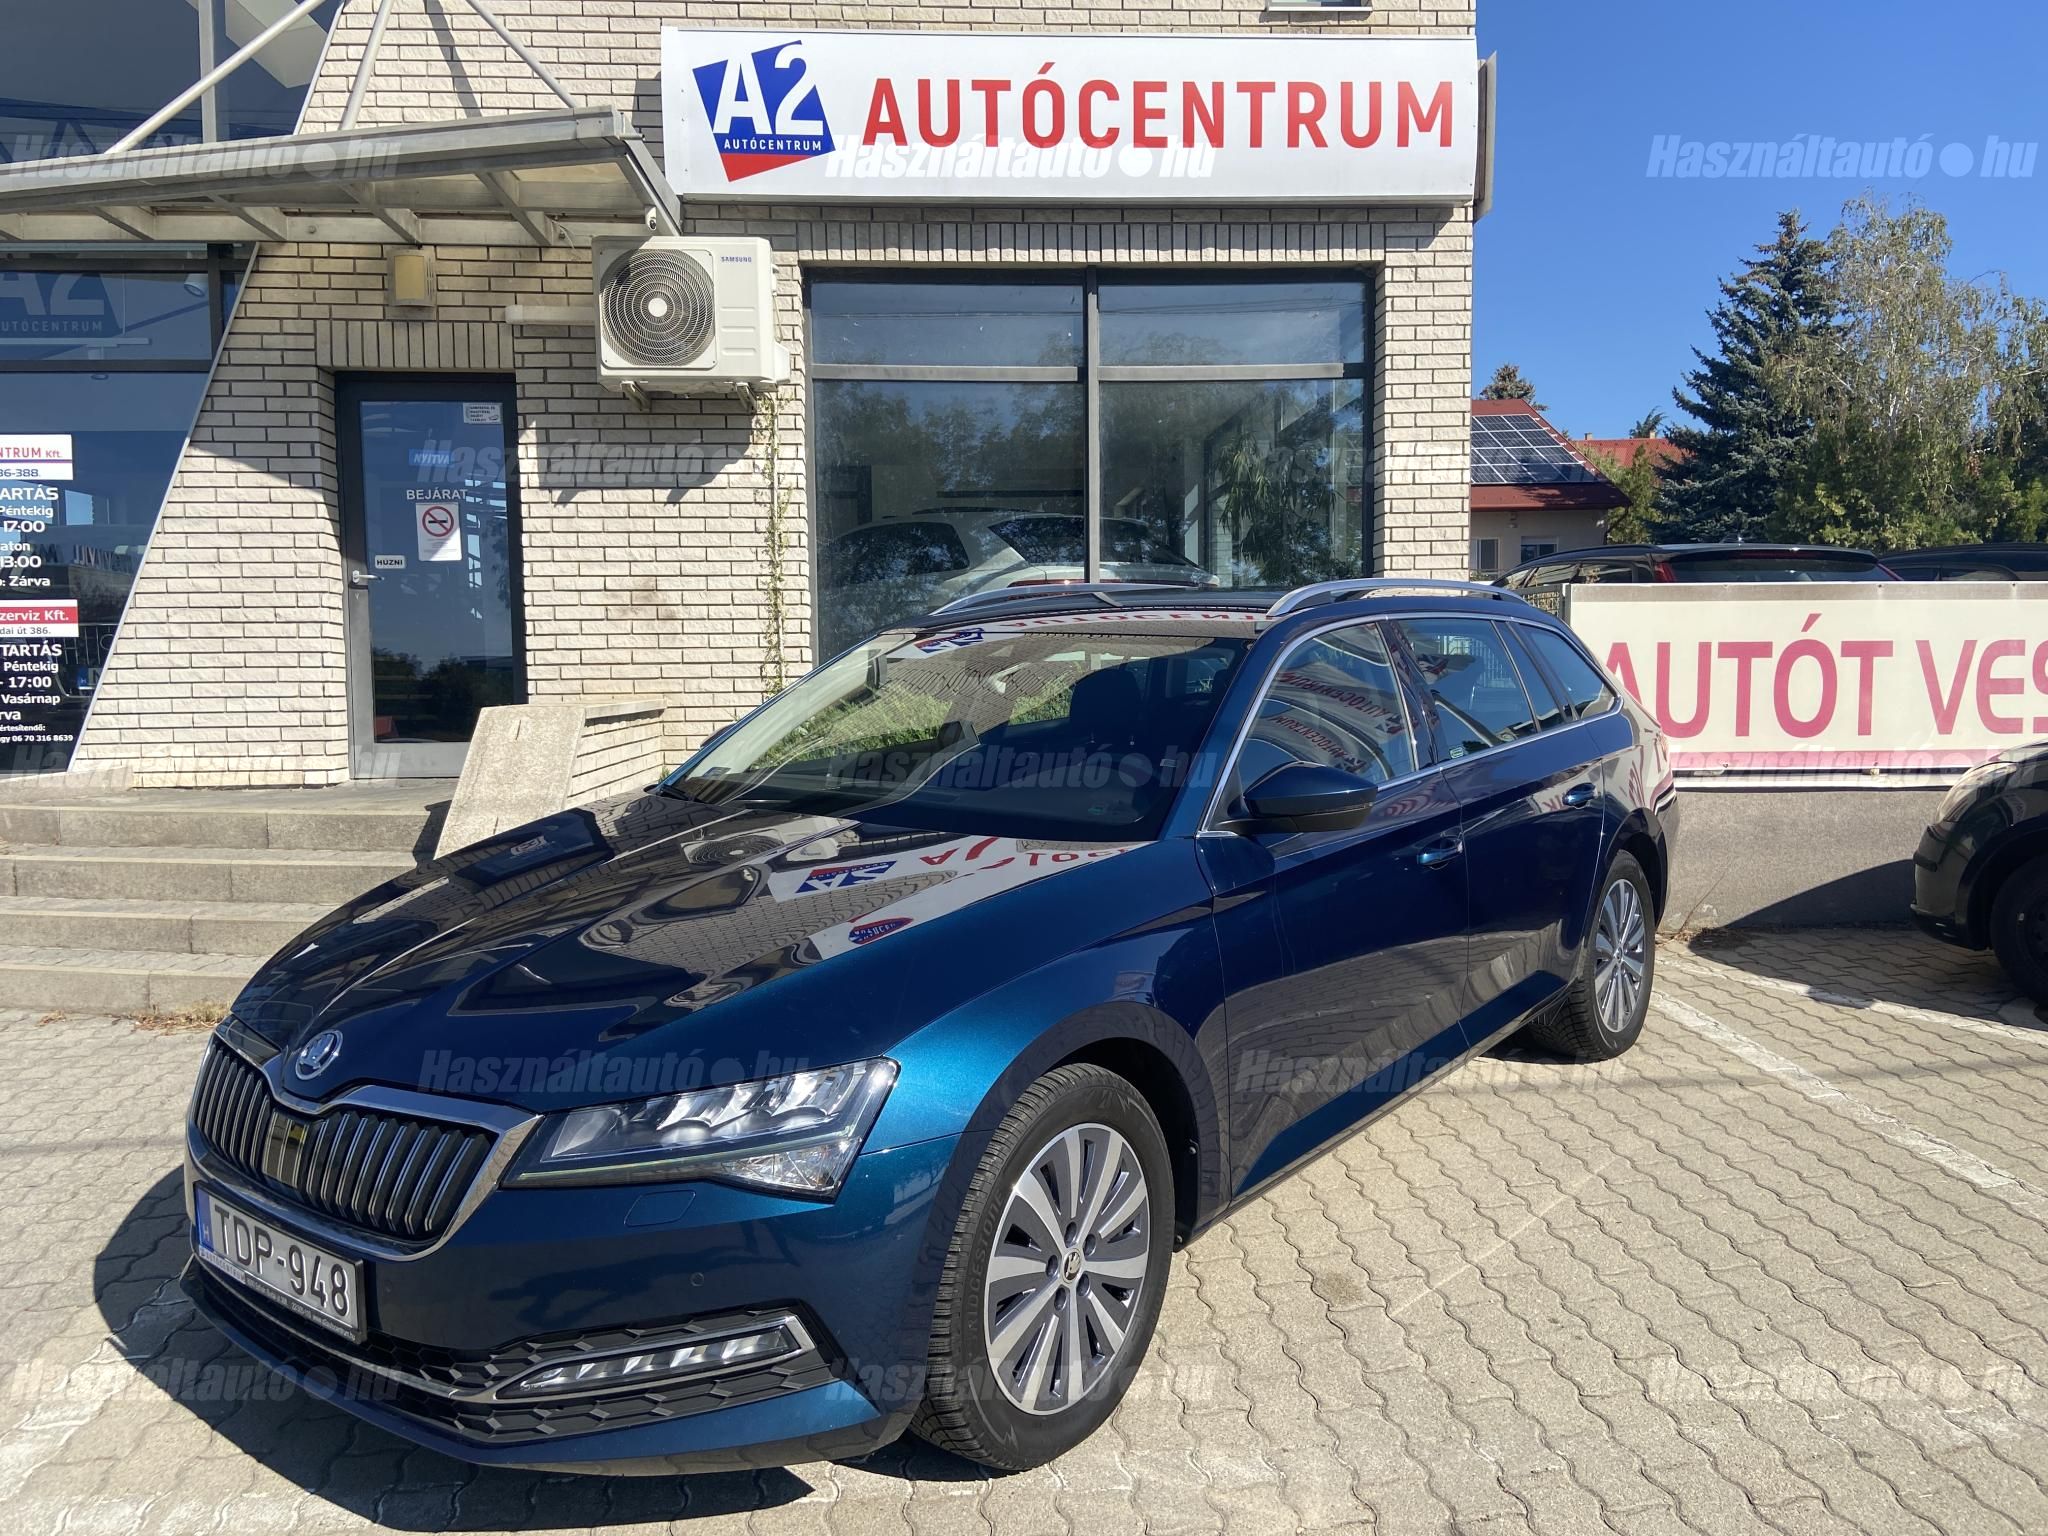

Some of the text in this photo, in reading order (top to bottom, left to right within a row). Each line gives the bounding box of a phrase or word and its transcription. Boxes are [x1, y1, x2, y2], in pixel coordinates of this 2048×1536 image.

[713, 43, 823, 136] A2
[862, 61, 1453, 149] AUTÓCENTRUM
[723, 137, 822, 152] AUTÓCENTRUM
[406, 487, 467, 500] BEJÁRAT
[3, 520, 46, 533] 17:00
[9, 575, 51, 587] Zárva
[44, 609, 70, 621] Kft.
[30, 626, 52, 635] 386.
[0, 639, 63, 657] TARTÁS
[4, 660, 59, 674] Péntekig
[8, 676, 52, 688] 17:00
[1604, 613, 2048, 739] AUTÓT VE
[1, 692, 61, 706] Vasárnap
[24, 734, 35, 742] 70
[36, 734, 52, 742] 316
[214, 1204, 349, 1317] TDP-948
